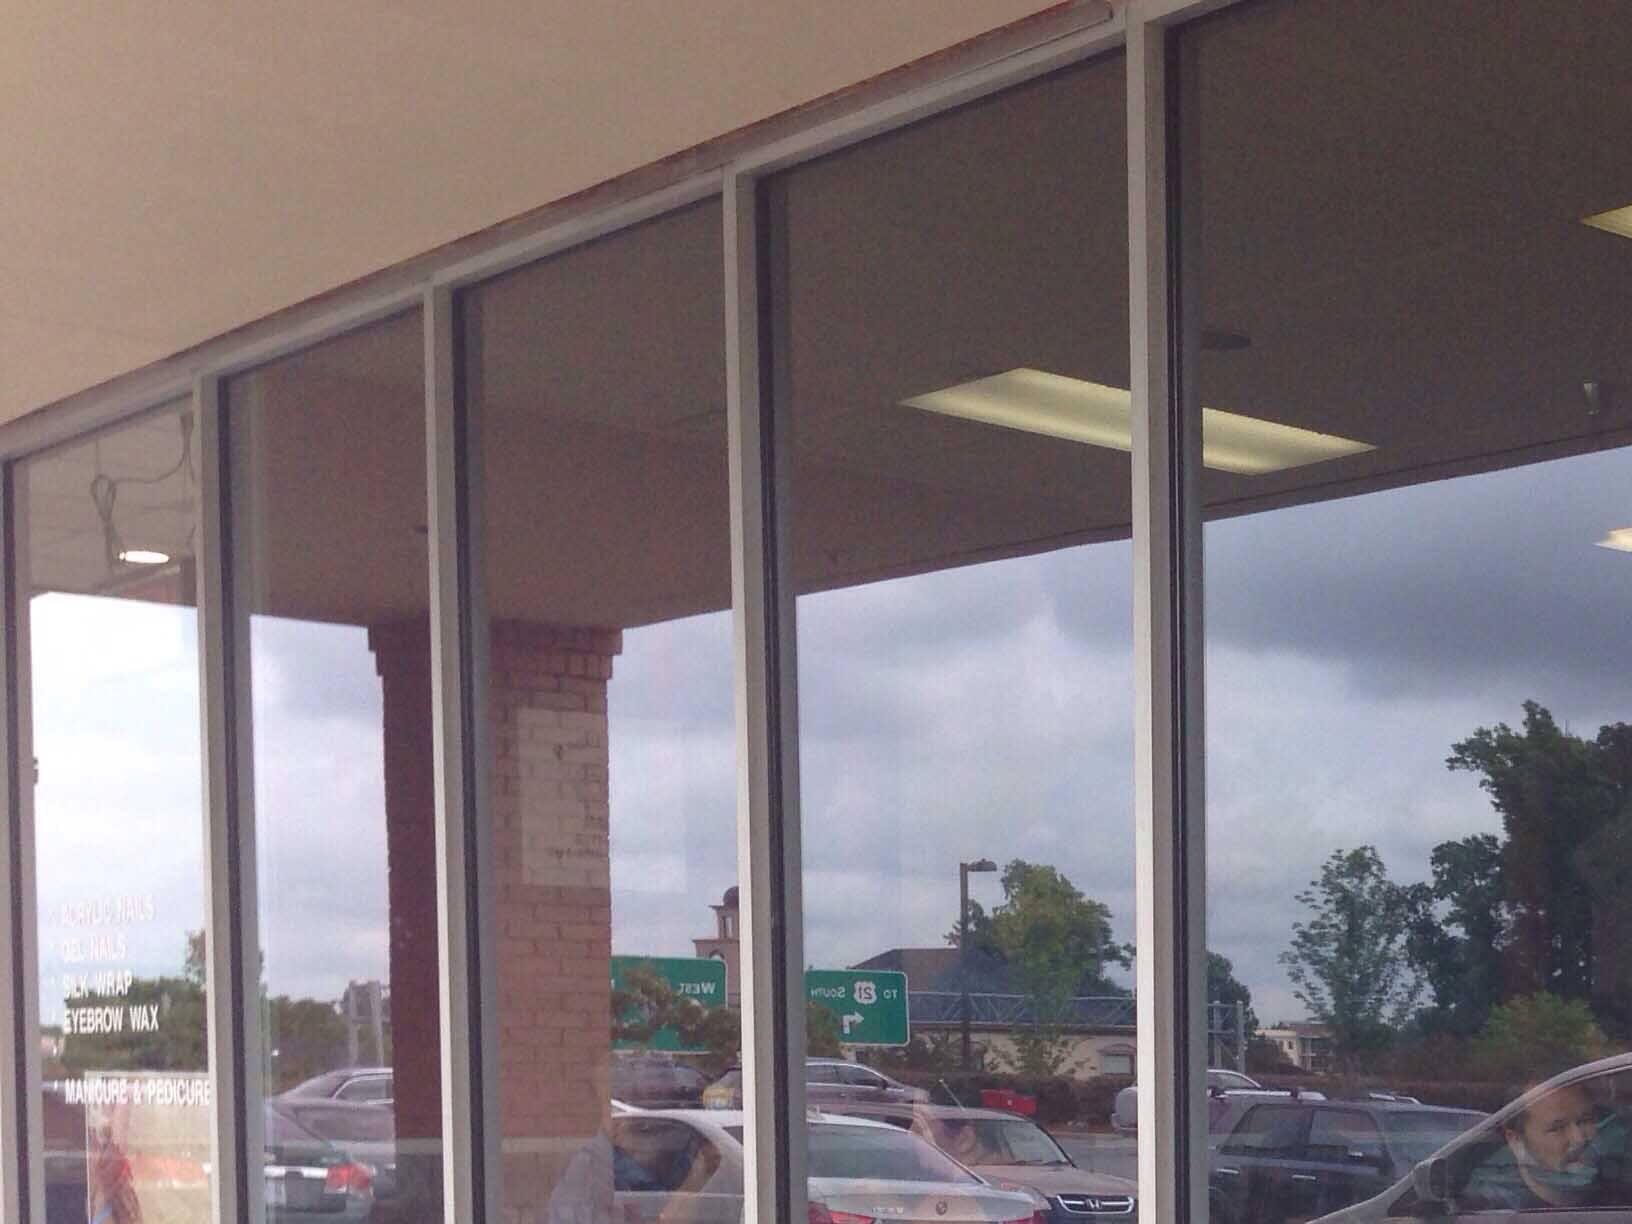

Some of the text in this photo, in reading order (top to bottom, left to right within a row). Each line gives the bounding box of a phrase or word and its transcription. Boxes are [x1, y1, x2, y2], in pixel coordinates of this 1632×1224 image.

[63, 970, 132, 999] SILK WRAP
[63, 1004, 159, 1034] EYEBROW WAX
[65, 1077, 211, 1105] MANICURE & PEDICURE
